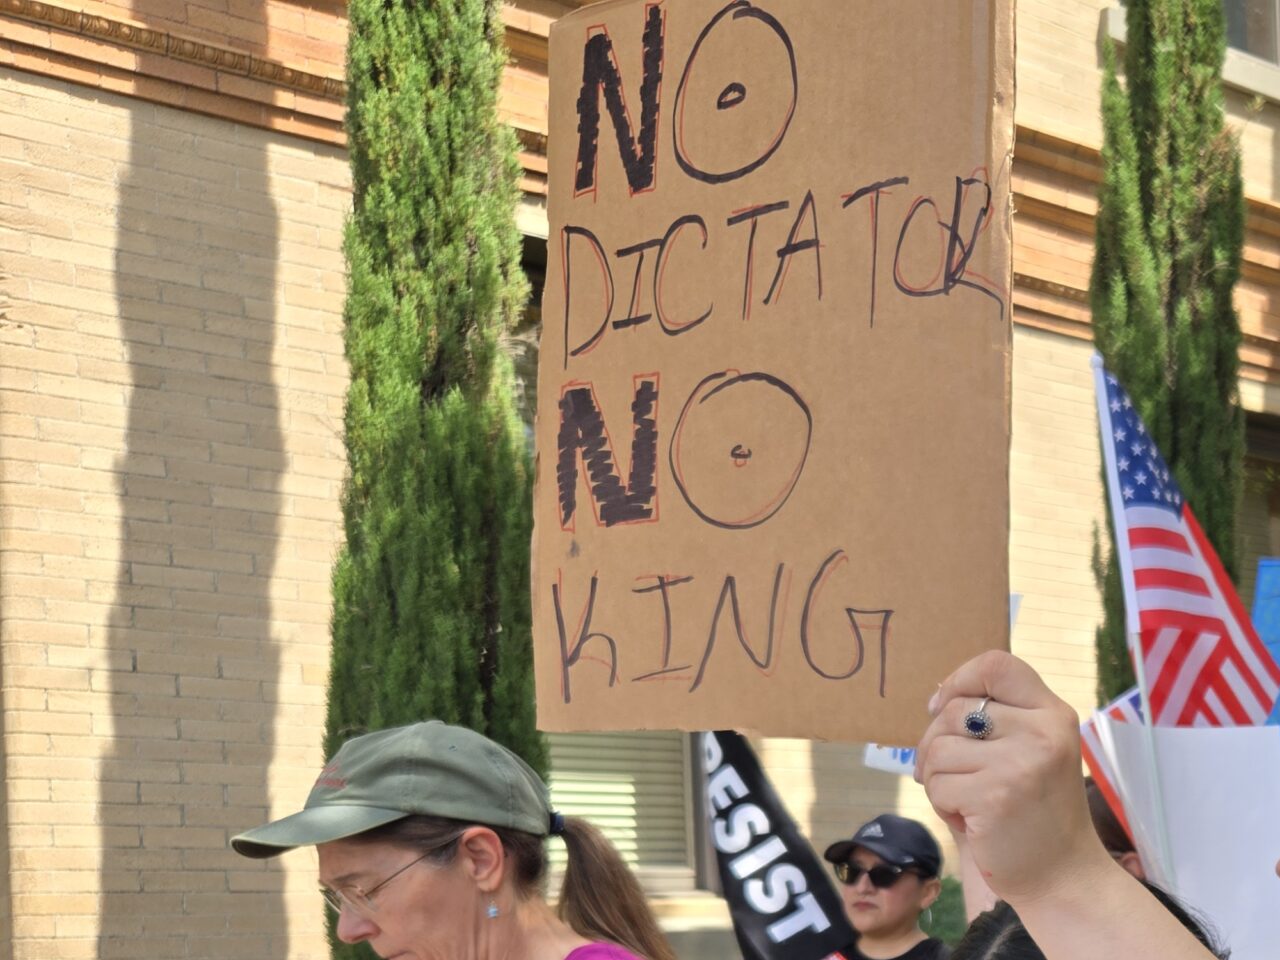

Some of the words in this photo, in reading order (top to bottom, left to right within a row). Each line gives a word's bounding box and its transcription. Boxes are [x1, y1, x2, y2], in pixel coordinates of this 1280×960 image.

[574, 0, 797, 199] NO
[562, 167, 1004, 369] DICTATOR
[557, 369, 812, 531] NO
[552, 549, 894, 704] KING
